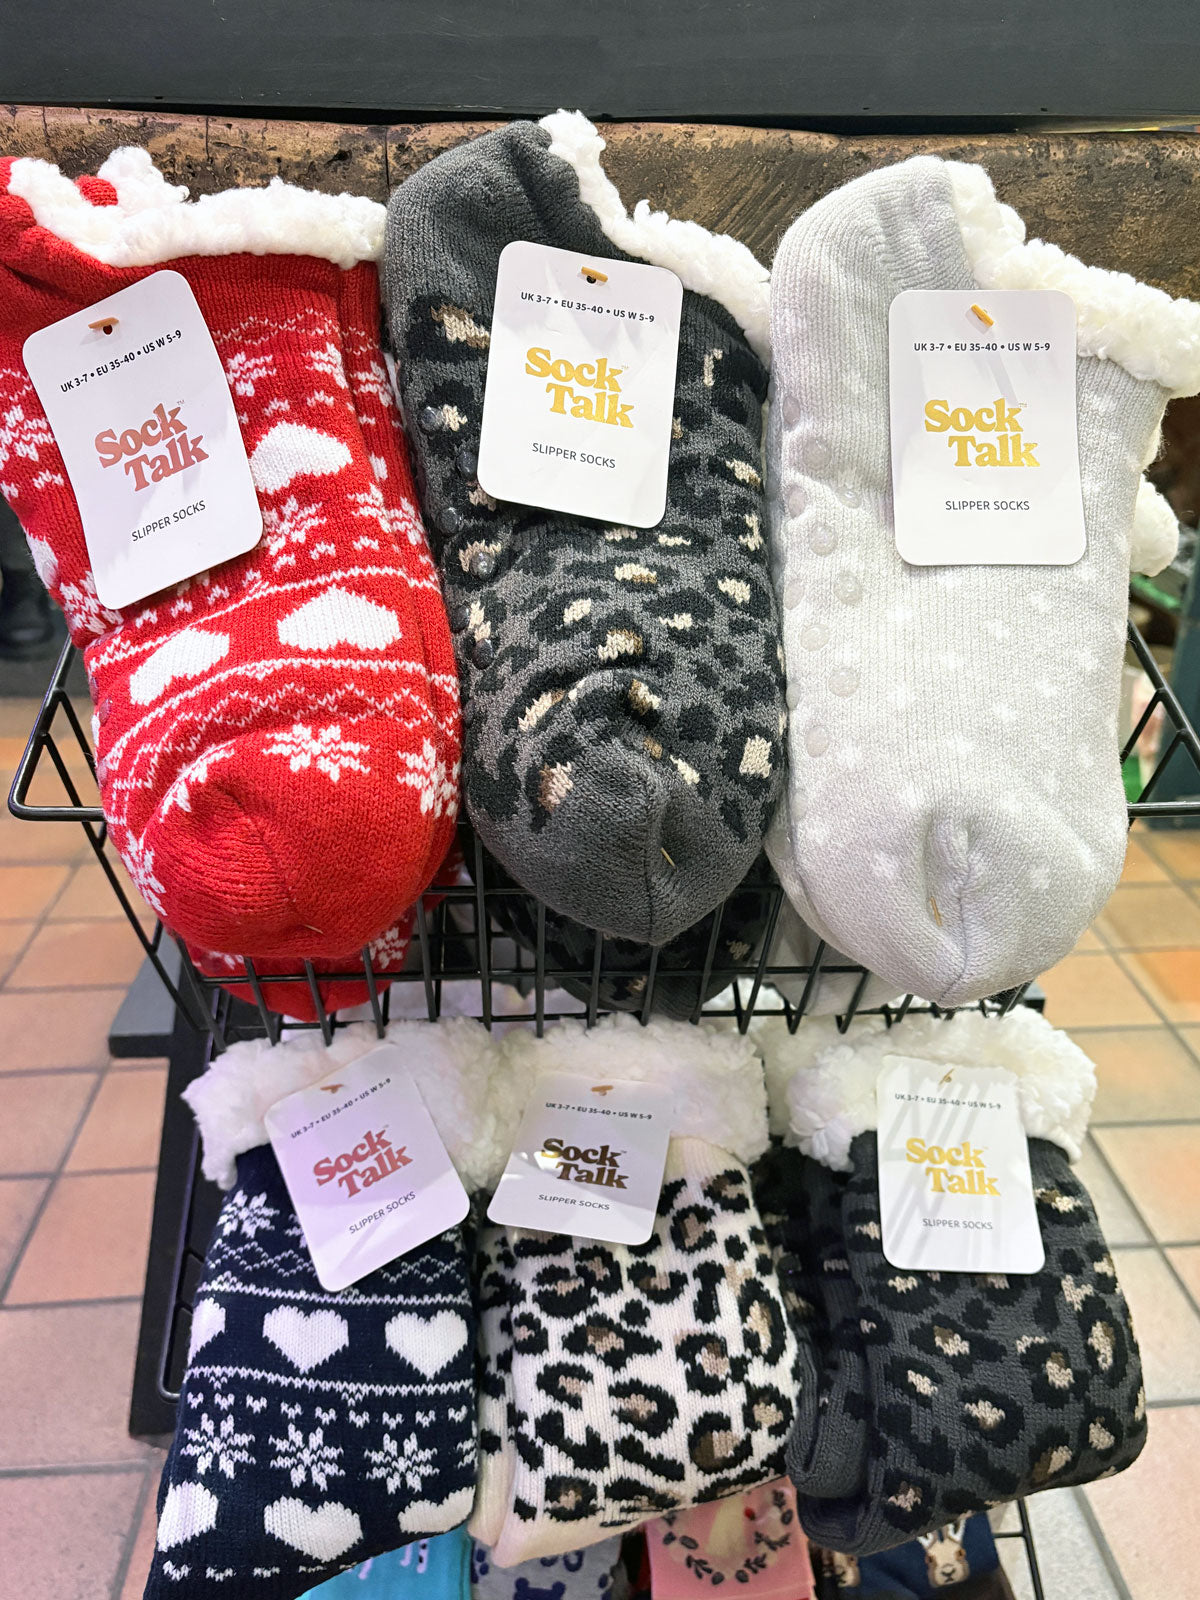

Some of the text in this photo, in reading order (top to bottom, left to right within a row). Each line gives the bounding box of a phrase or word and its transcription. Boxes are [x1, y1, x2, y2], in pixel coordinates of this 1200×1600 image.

[521, 292, 534, 301] UK
[536, 295, 552, 304] 3-7
[561, 300, 574, 308] EU
[576, 302, 603, 314] 35-40
[639, 313, 655, 323] 5-9
[60, 330, 182, 393] UK 3-7 EU 35-40 US W 5-9
[914, 343, 1050, 351] UK 3-7 EU 35-40 US W 5-9
[525, 347, 623, 392] Sock
[546, 383, 634, 428] Talk
[924, 398, 1023, 432] Sock
[95, 403, 187, 469] Sock
[948, 433, 1040, 467] Talk
[124, 432, 209, 492] Talk
[532, 443, 616, 468] SLIPPER SOCKS
[131, 500, 206, 542] SLIPPER SOCKS
[945, 501, 1030, 510] SLIPPER SOCKS
[291, 1078, 391, 1139] UK 3-7 EU 35-40 US W 5-9
[588, 1107, 611, 1115] 35-40
[938, 1098, 960, 1106] 35-40
[313, 1130, 392, 1186] Sock
[541, 1138, 622, 1168] Sock
[905, 1138, 986, 1168] Sock
[338, 1146, 413, 1198] Talk
[556, 1162, 629, 1189] Talk
[925, 1167, 1001, 1196] Talk
[349, 1191, 416, 1234] SLIPPER SOCKS
[538, 1194, 610, 1210] SLIPPER SOCKS
[922, 1219, 993, 1229] SLIPPER SOCKS
